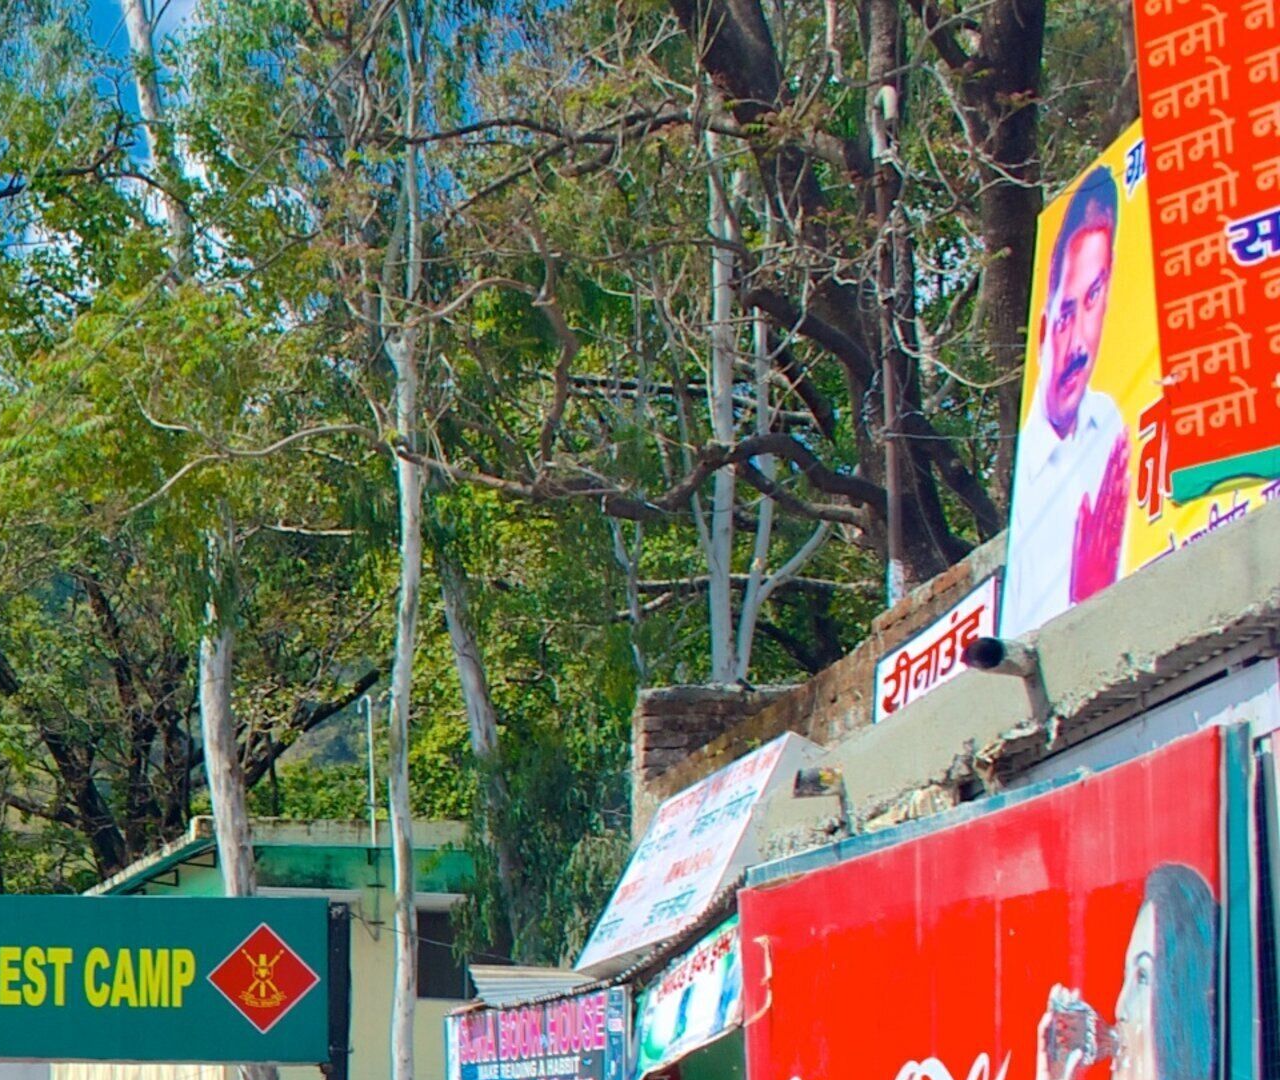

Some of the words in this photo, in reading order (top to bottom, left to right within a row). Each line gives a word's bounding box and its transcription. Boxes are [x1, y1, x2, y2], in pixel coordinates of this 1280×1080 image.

[1144, 3, 1228, 67] नमो
[1148, 55, 1232, 119] नमो
[1152, 108, 1236, 172] नमो
[1156, 161, 1240, 225] नमो
[1163, 267, 1248, 330] नमो
[1166, 321, 1253, 383] नमो
[1171, 375, 1258, 437] नमो
[85, 947, 196, 1009] CAMP
[546, 991, 607, 1056] HOUSE
